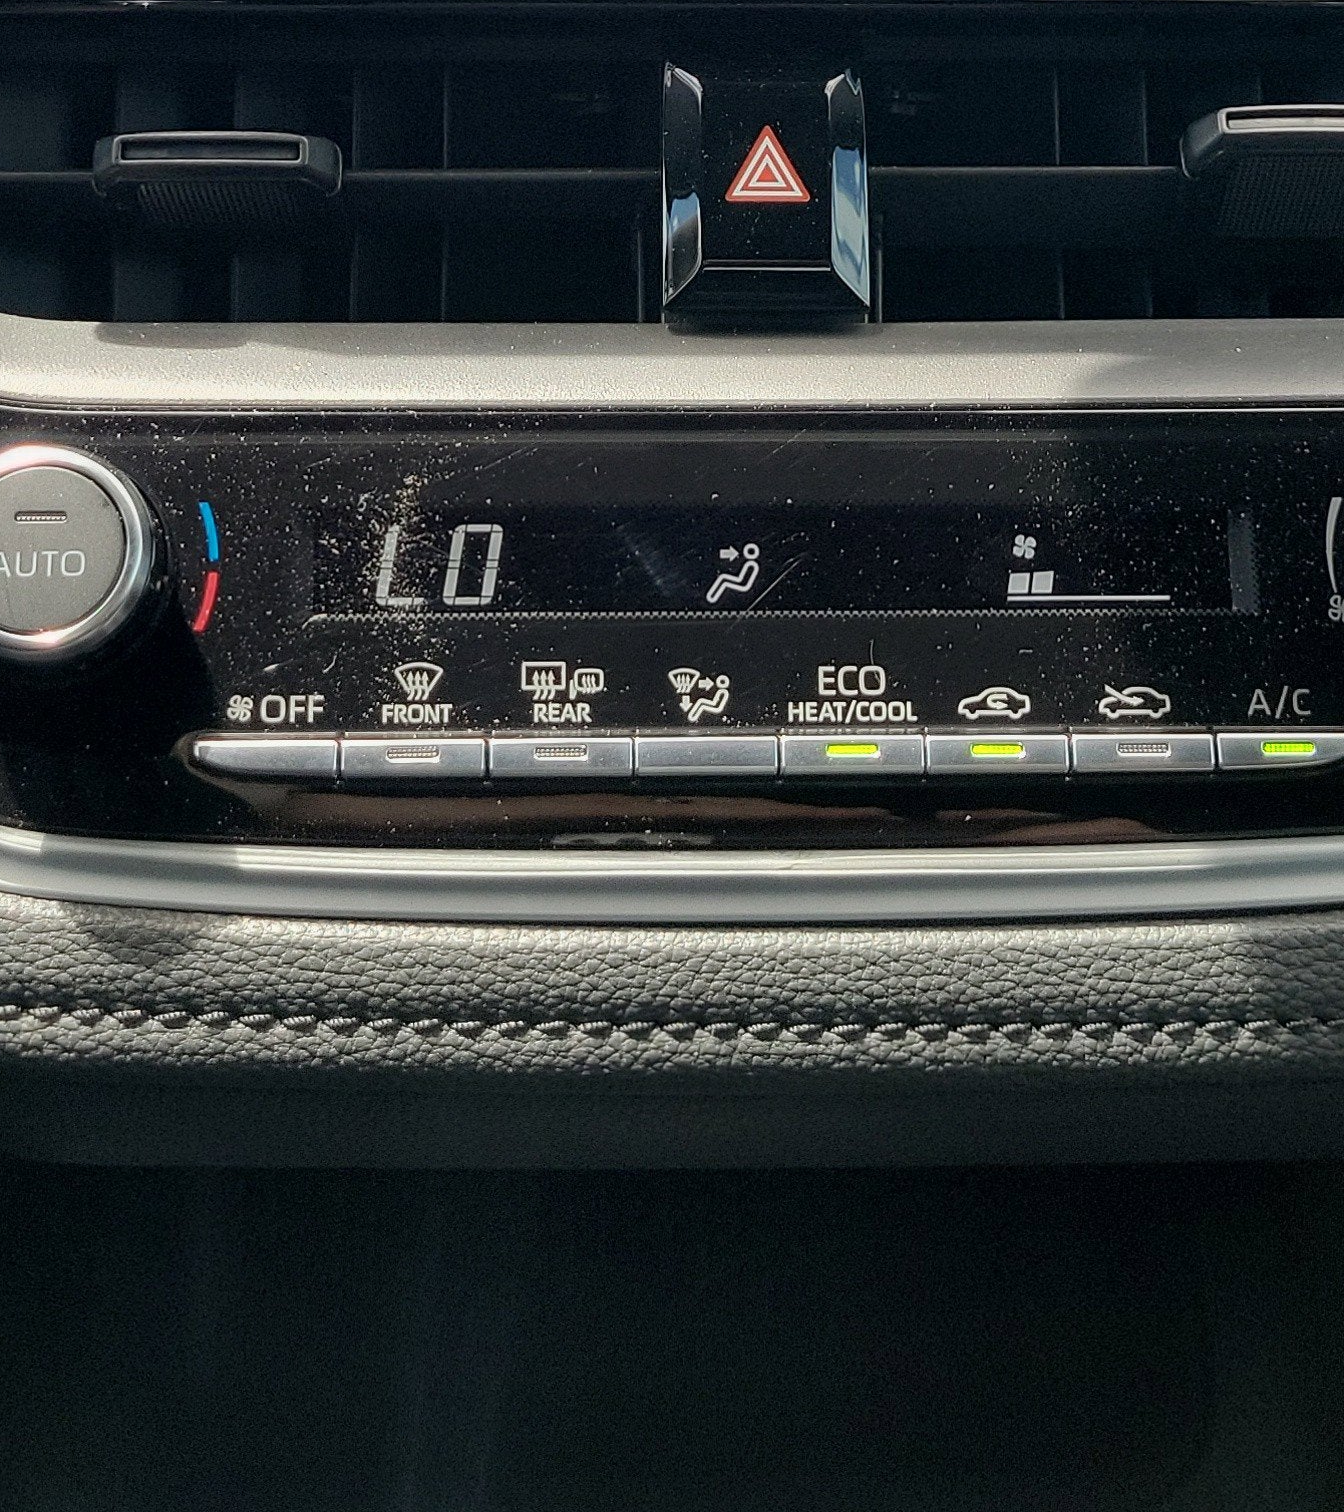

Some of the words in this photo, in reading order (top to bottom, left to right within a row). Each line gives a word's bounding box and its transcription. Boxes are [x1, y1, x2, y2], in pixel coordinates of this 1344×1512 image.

[817, 665, 887, 696] ECO
[260, 694, 324, 724] OFF
[381, 702, 452, 725] FRONT
[533, 702, 592, 723] REAR
[787, 701, 918, 724] HEAT/COOL
[1247, 688, 1311, 718] A/C
